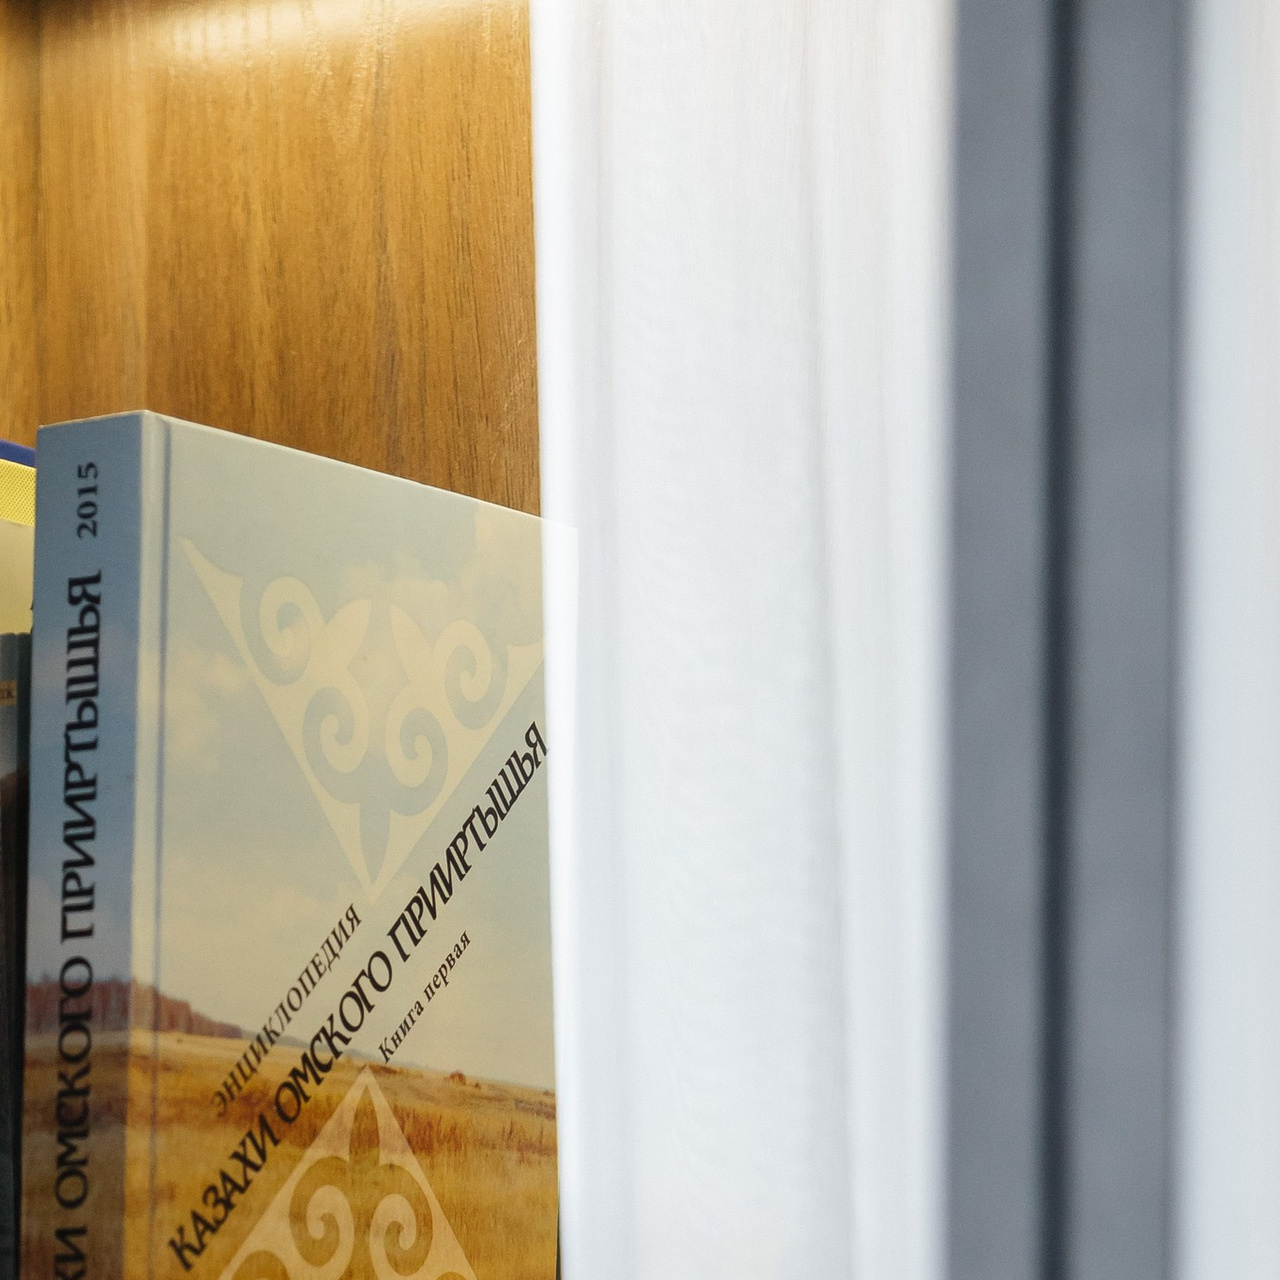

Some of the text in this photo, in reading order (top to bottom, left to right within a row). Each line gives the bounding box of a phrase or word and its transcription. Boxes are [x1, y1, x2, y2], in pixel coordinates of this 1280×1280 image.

[76, 461, 99, 539] 2015
[60, 570, 102, 944] ПРИИРТЫШЬЯ
[54, 956, 94, 1210] ОМСКОГО
[167, 720, 549, 1273] КАЗАХИ ОМСКОГО ПРИИРТЫШЬЯ
[211, 902, 363, 1119] ЭНЦИКЛОПЕДИЯ
[377, 928, 473, 1065] Книга первая
